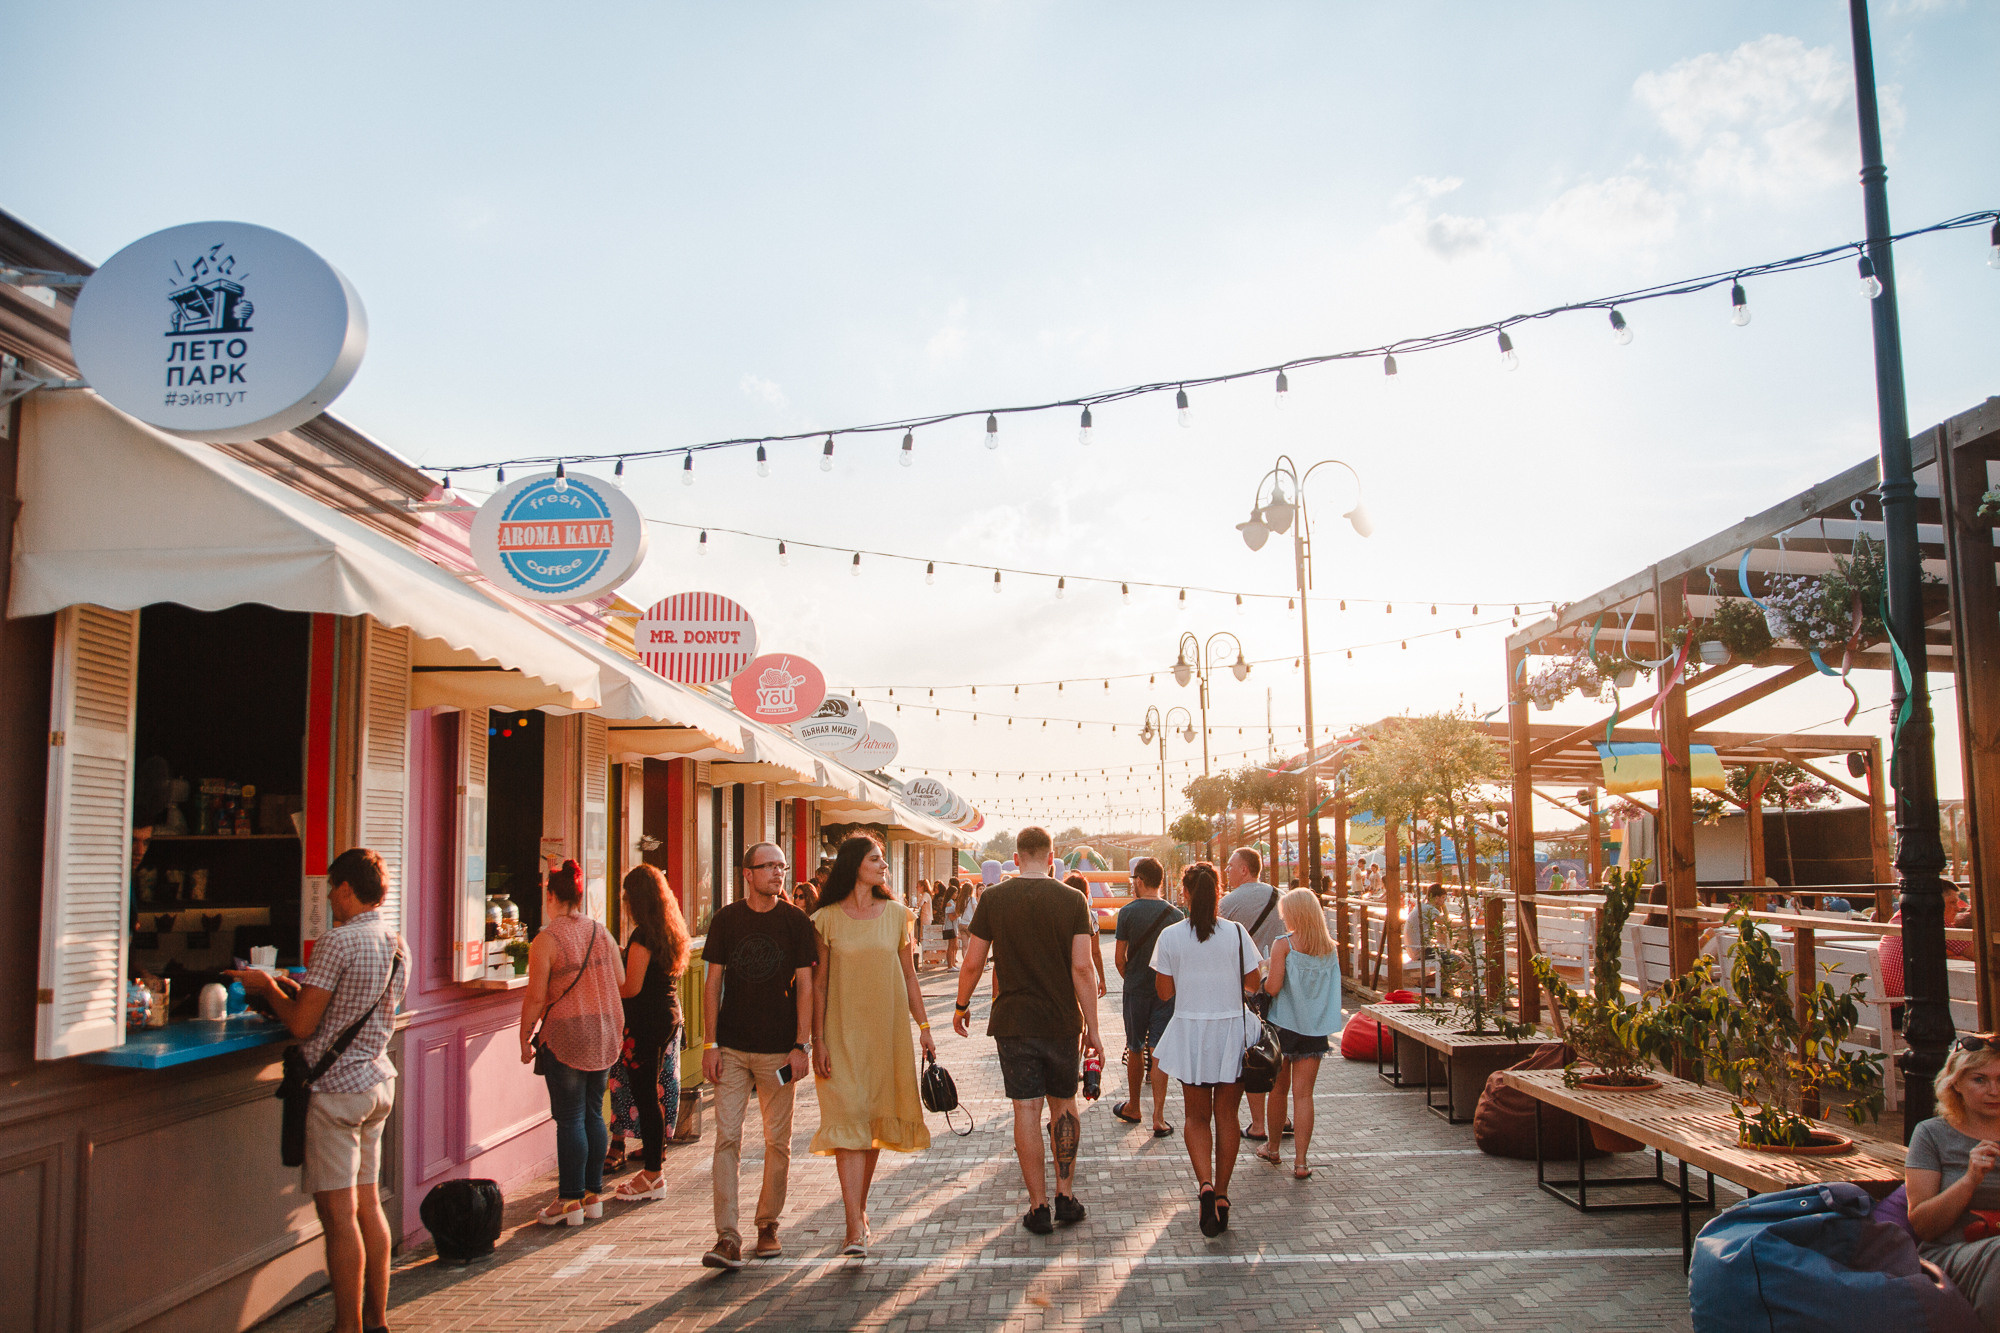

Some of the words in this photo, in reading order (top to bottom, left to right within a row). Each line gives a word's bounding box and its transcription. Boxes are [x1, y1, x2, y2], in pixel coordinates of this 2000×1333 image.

[167, 338, 247, 362] ЛЕТО
[167, 363, 248, 387] ПАРК
[165, 390, 248, 407] #эйятут
[530, 494, 582, 510] fresh
[500, 525, 561, 547] AROMA
[565, 524, 612, 545] KAVA
[526, 557, 583, 576] coffee
[650, 629, 678, 644] MR.
[684, 630, 741, 645] DONUT
[802, 725, 829, 738] ПЬЯНАЯ
[832, 725, 858, 737] МИДИЯ
